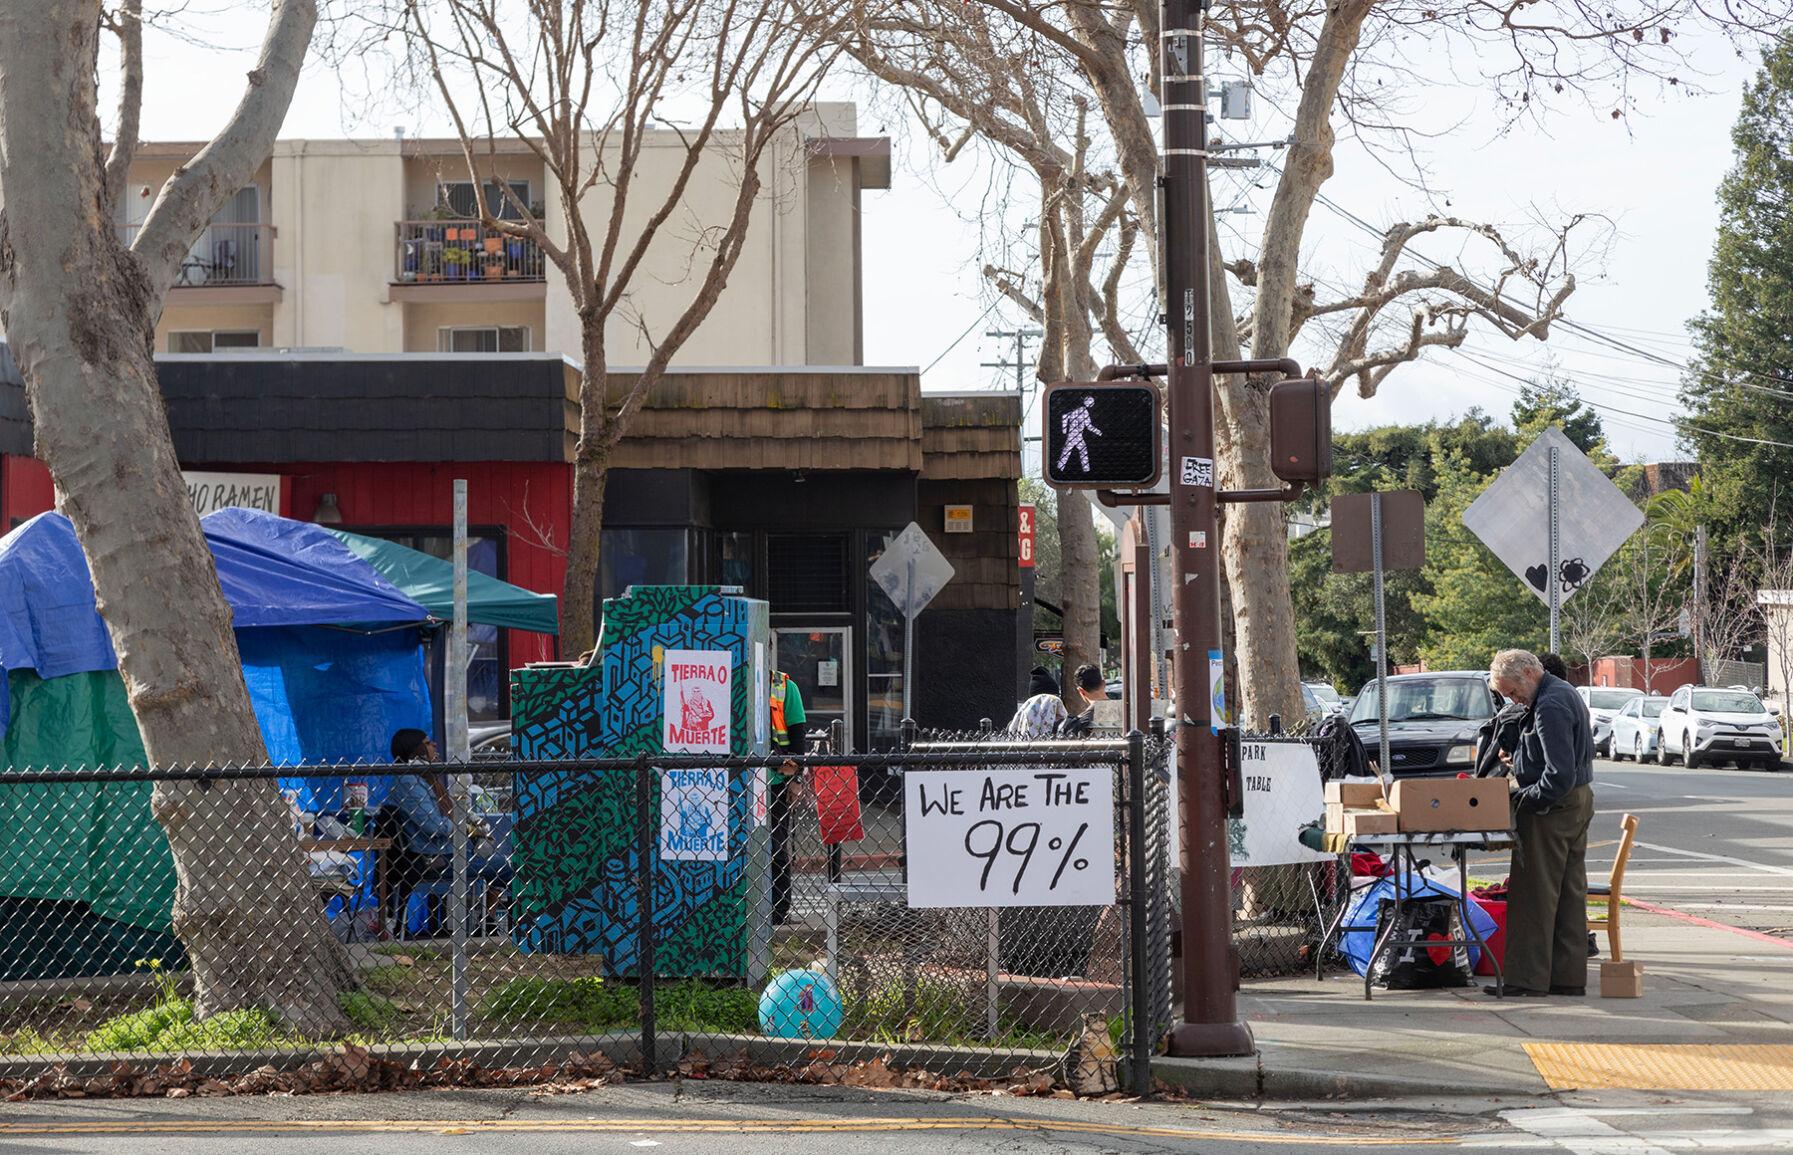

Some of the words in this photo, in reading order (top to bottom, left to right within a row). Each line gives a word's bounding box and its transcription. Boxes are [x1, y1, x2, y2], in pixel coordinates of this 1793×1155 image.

[1185, 458, 1211, 475] FREE
[211, 483, 275, 513] RAMEN
[671, 664, 716, 683] TIERRA
[717, 665, 728, 685] O
[669, 723, 727, 745] MUERTE
[1241, 744, 1267, 761] PARK
[1246, 776, 1272, 793] TABLE
[919, 782, 965, 818] WE
[979, 776, 1029, 813] ARE
[1033, 773, 1091, 807] THE
[964, 819, 1090, 896] 99%
